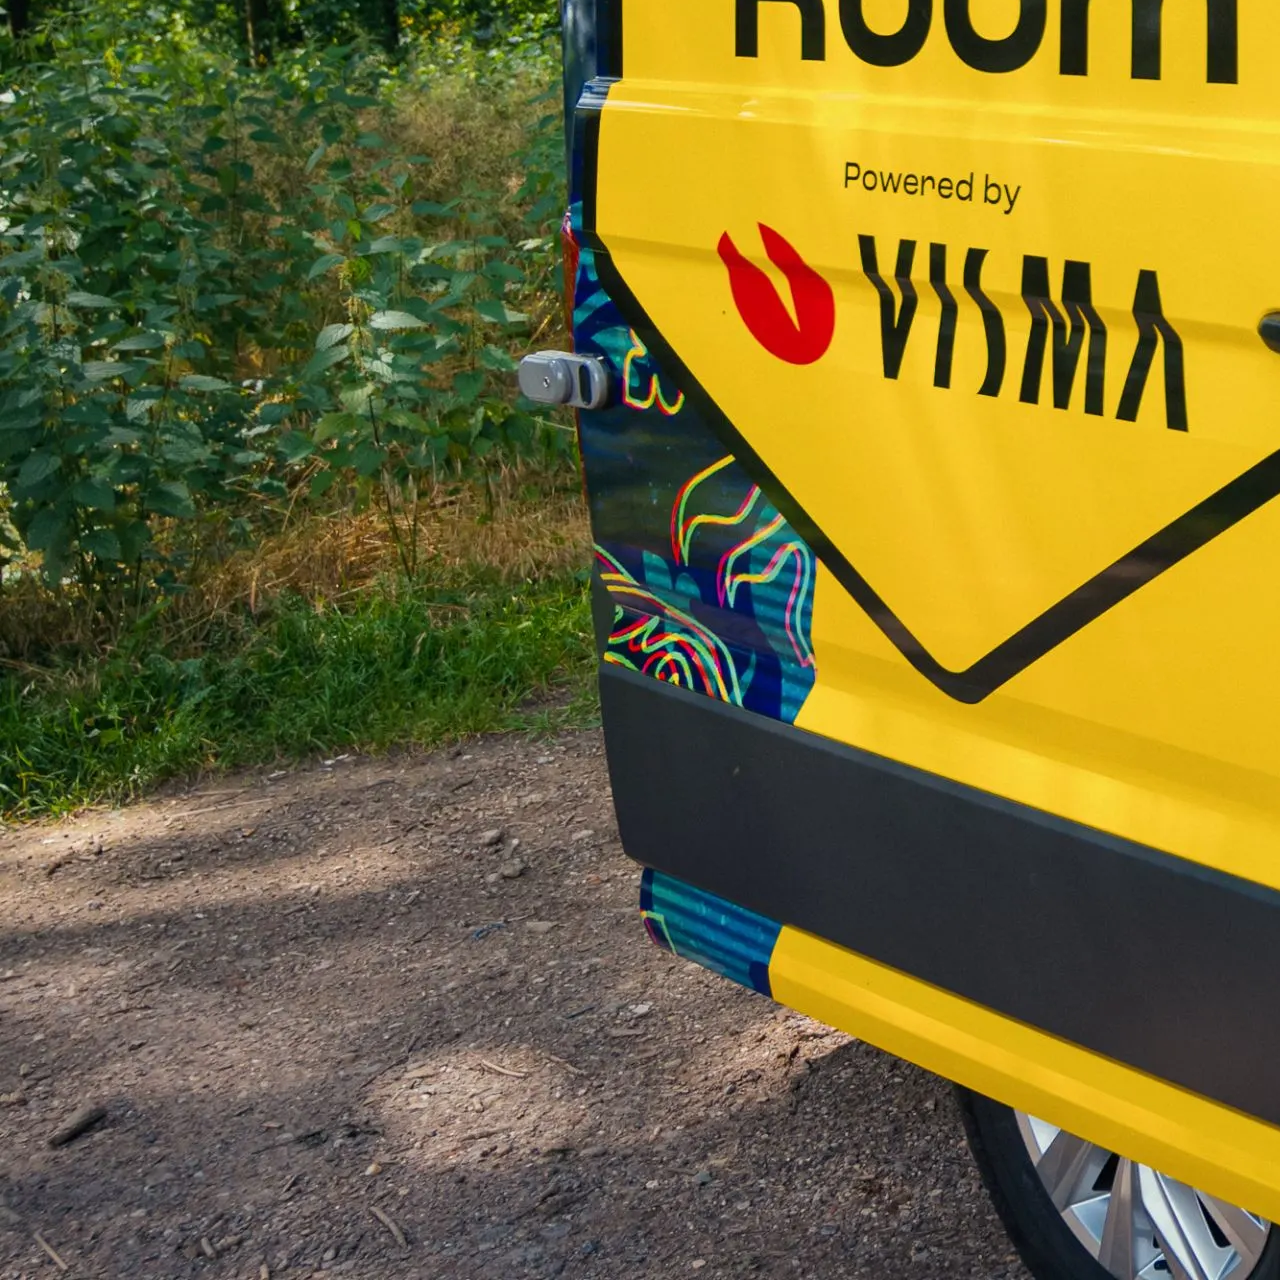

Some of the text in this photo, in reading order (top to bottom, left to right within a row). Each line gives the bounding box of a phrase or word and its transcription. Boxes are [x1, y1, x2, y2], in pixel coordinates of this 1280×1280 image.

[843, 161, 1021, 216] Powered by
[857, 233, 1190, 433] VISMA
